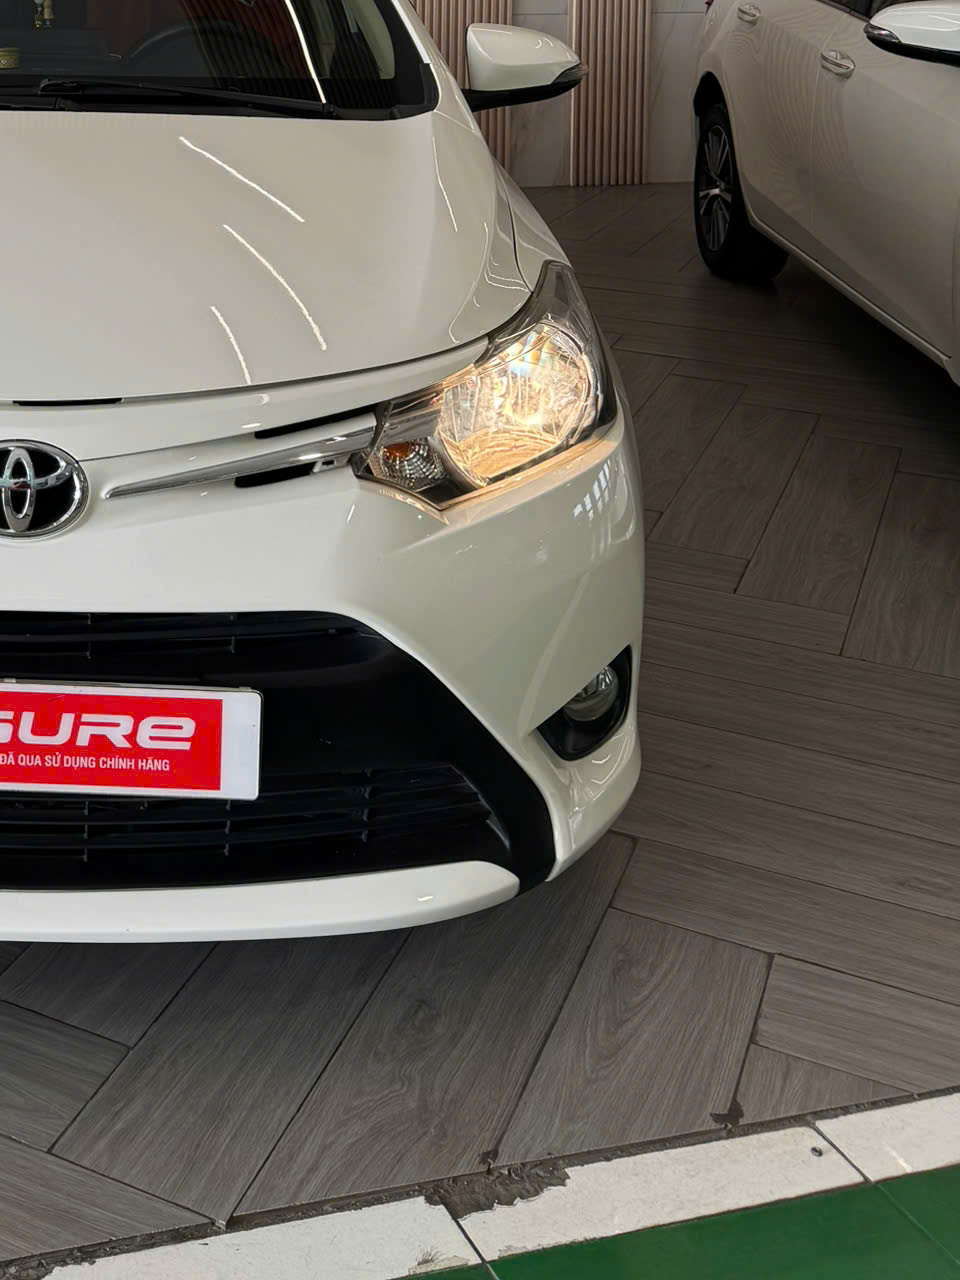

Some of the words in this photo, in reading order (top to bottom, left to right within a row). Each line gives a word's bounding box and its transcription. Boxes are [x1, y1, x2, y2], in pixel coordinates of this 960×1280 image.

[0, 751, 16, 766] ĐÃ
[18, 753, 42, 766] QUA
[44, 751, 62, 767] SỬ
[63, 755, 96, 771] DỤNG
[99, 755, 135, 770] CHÍNH
[138, 756, 171, 771] HÃNG
